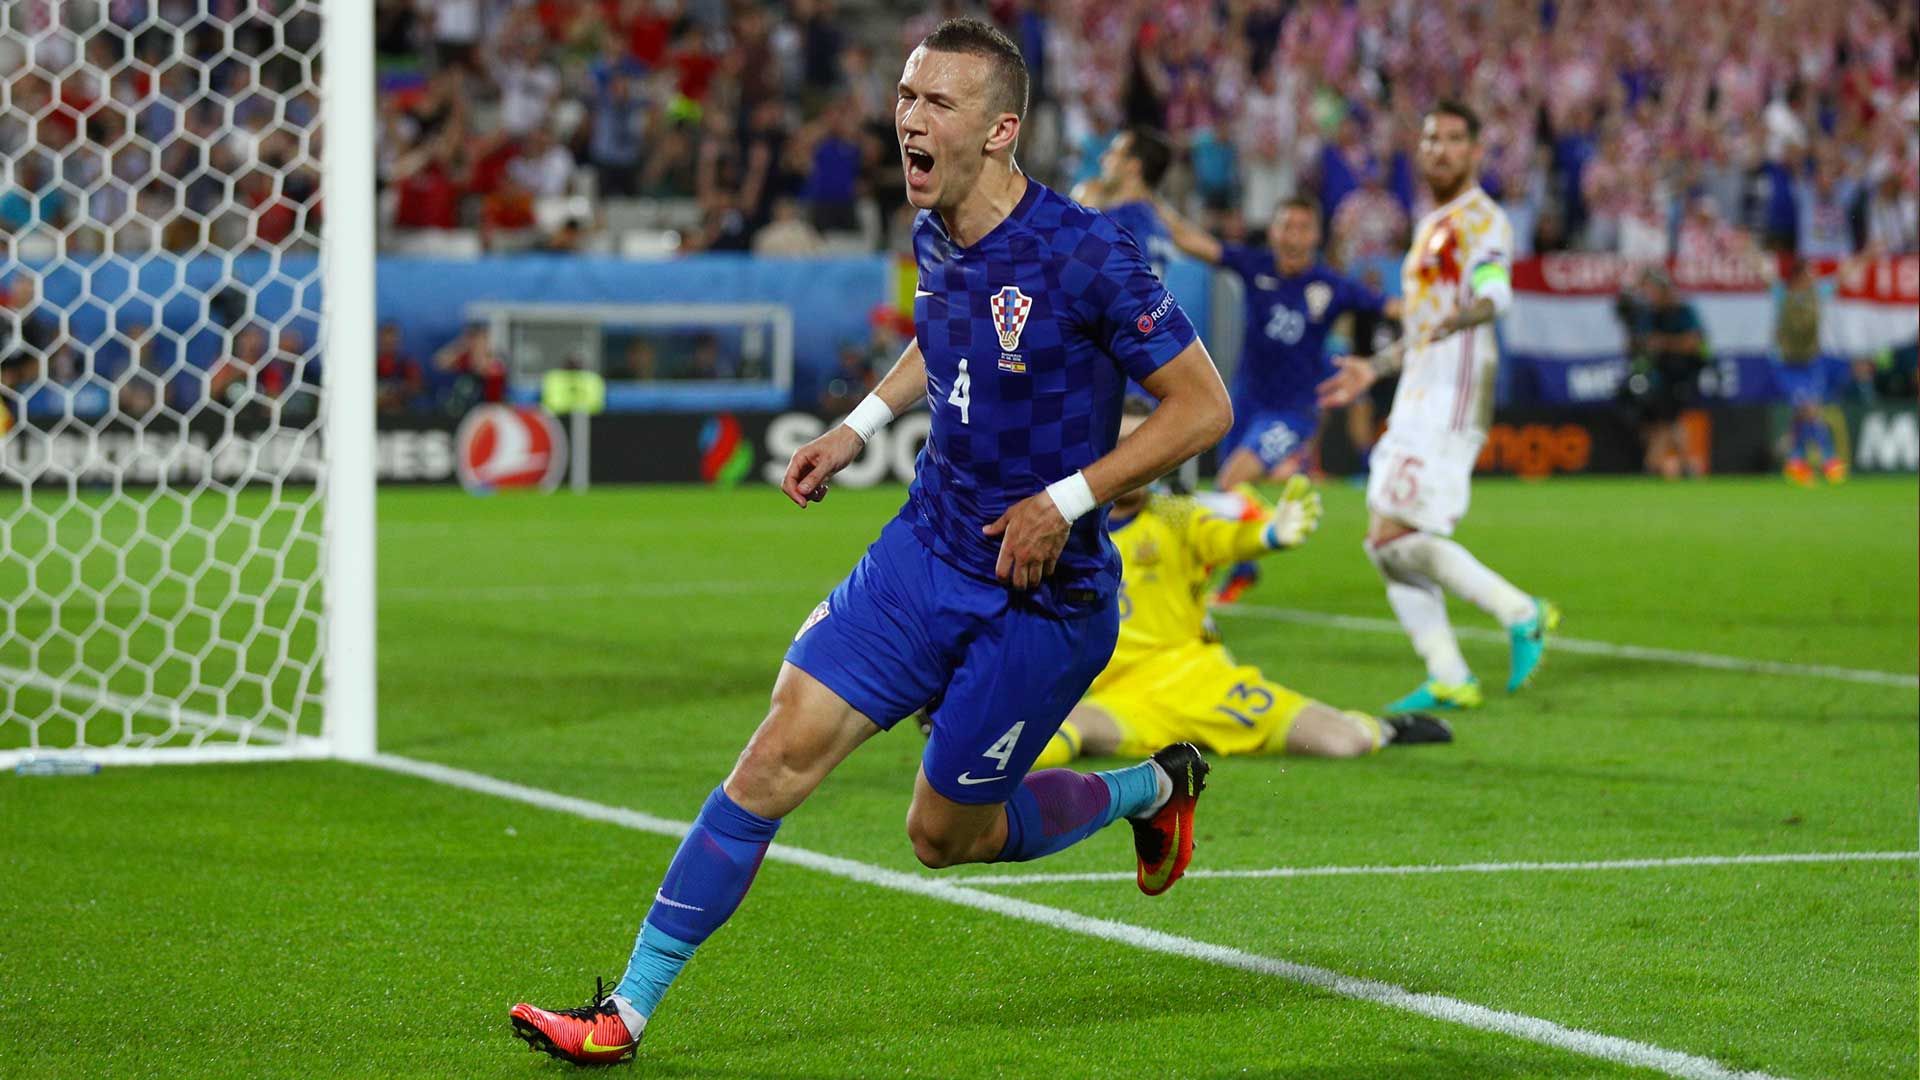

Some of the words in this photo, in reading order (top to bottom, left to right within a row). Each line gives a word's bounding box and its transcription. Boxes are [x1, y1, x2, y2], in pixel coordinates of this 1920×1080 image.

[948, 358, 971, 424] 4
[1215, 681, 1275, 728] 13
[982, 720, 1026, 771] 4
